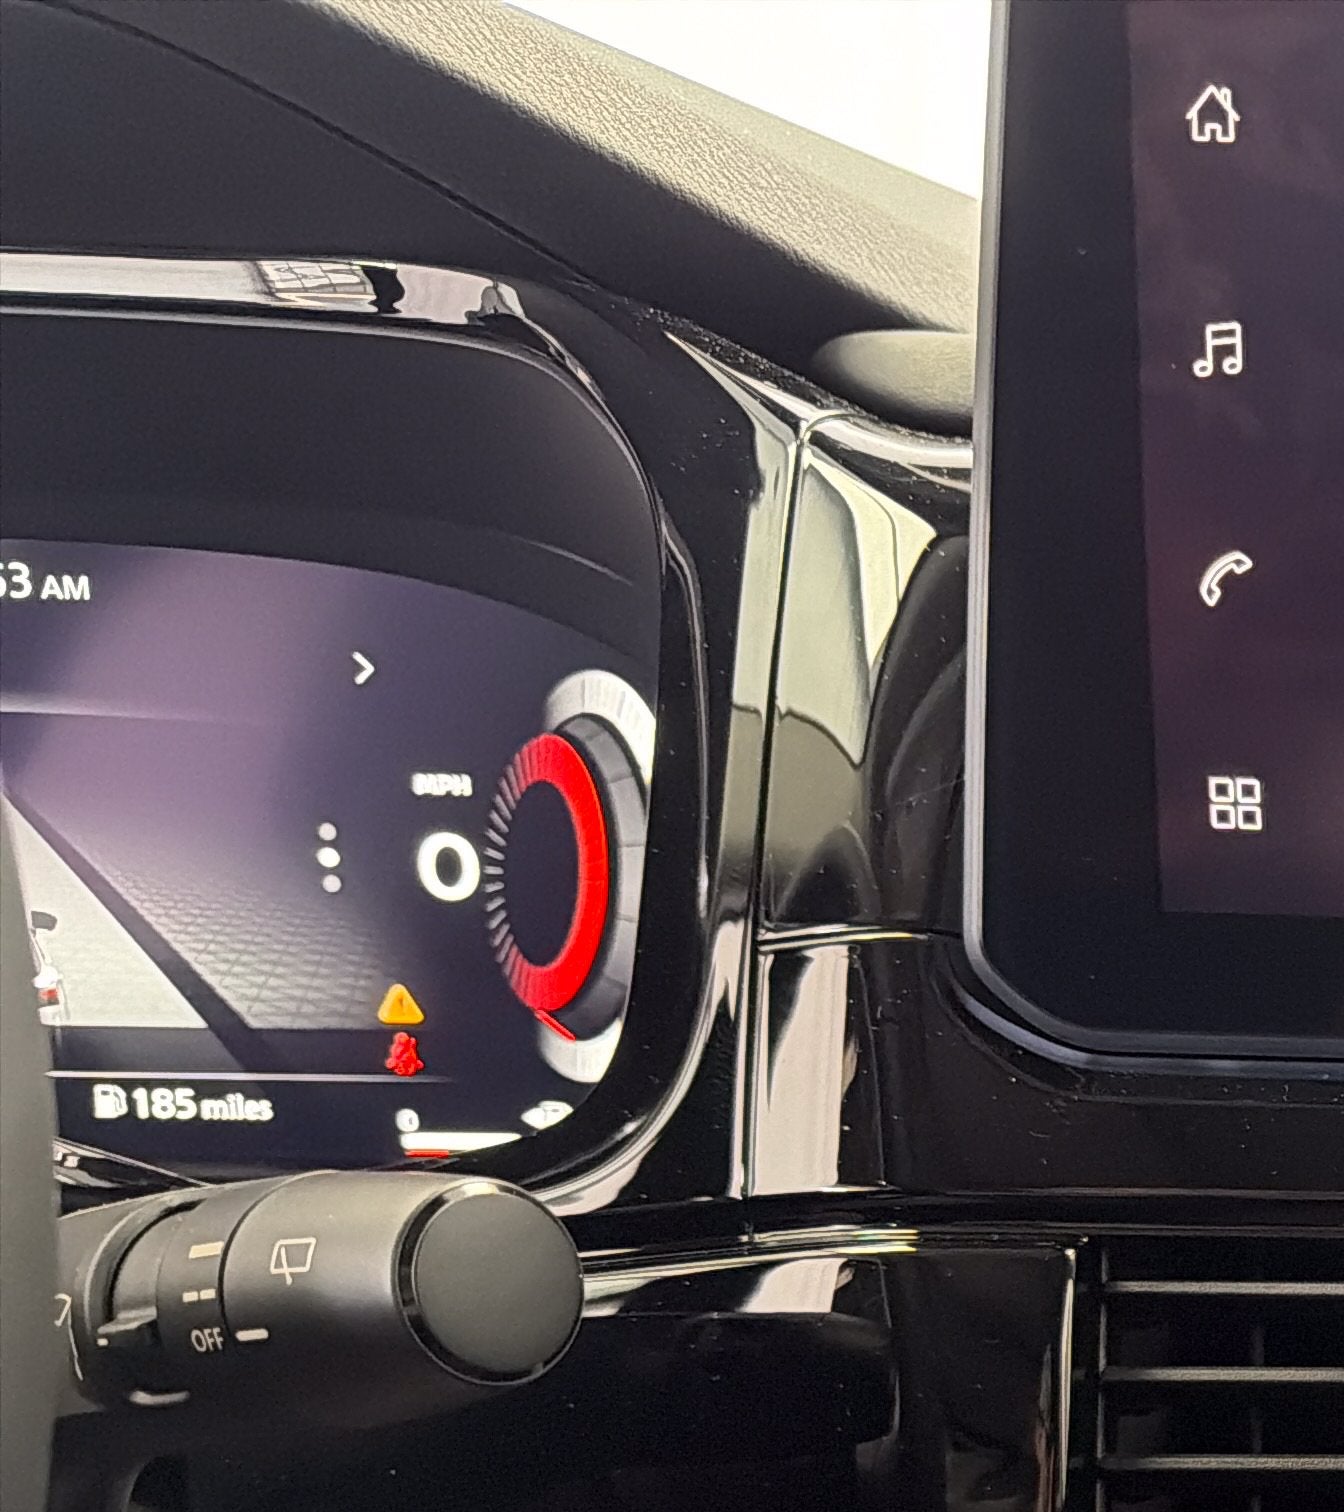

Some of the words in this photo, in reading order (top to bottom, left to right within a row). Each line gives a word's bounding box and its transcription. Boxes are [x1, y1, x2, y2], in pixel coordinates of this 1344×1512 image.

[0, 561, 33, 599] 3
[40, 574, 91, 601] AM
[416, 831, 481, 902] 0
[131, 1087, 198, 1120] 185
[199, 1092, 274, 1122] miles
[190, 1327, 224, 1352] OFF
